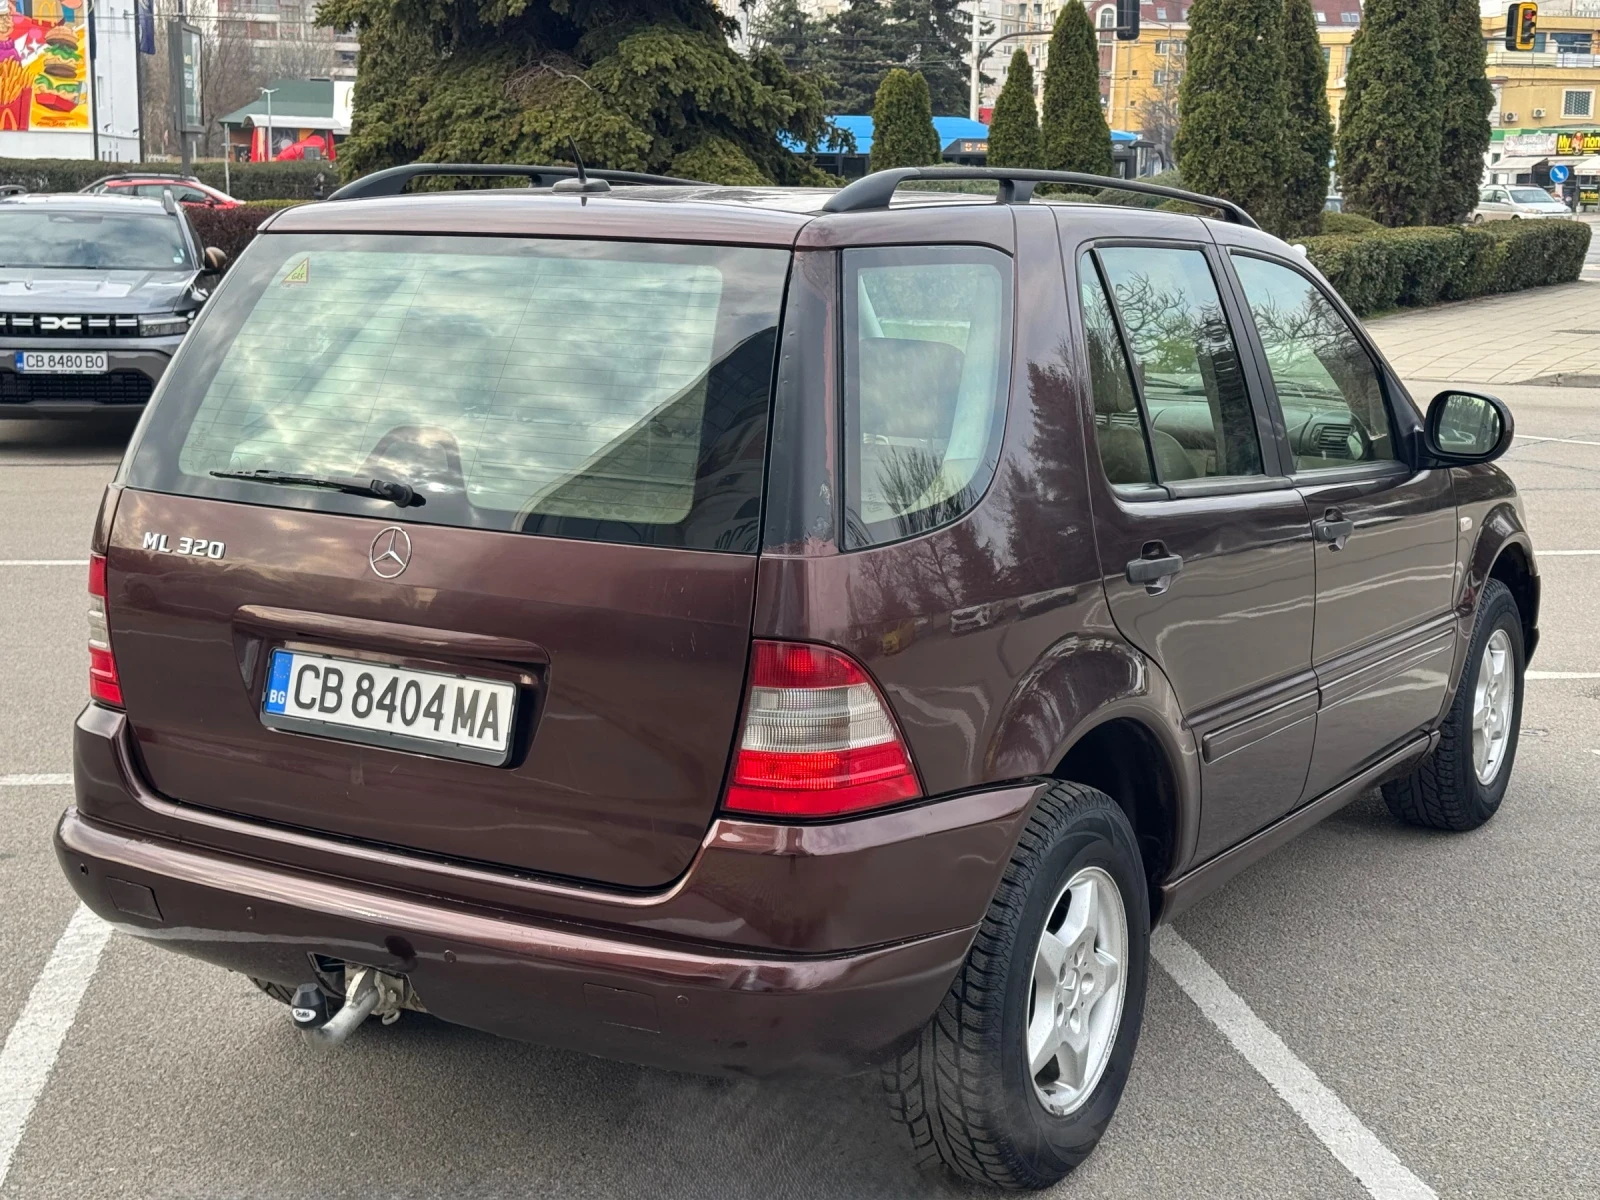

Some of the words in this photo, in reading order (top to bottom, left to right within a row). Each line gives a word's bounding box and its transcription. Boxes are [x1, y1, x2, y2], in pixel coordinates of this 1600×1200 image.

[26, 354, 45, 368] CB
[48, 354, 83, 368] 8480
[85, 355, 104, 369] BO
[142, 531, 173, 553] ML
[177, 536, 226, 559] 320
[269, 689, 286, 705] BG
[294, 663, 344, 714] CB
[351, 672, 446, 732] 8404
[451, 686, 500, 742] MA
